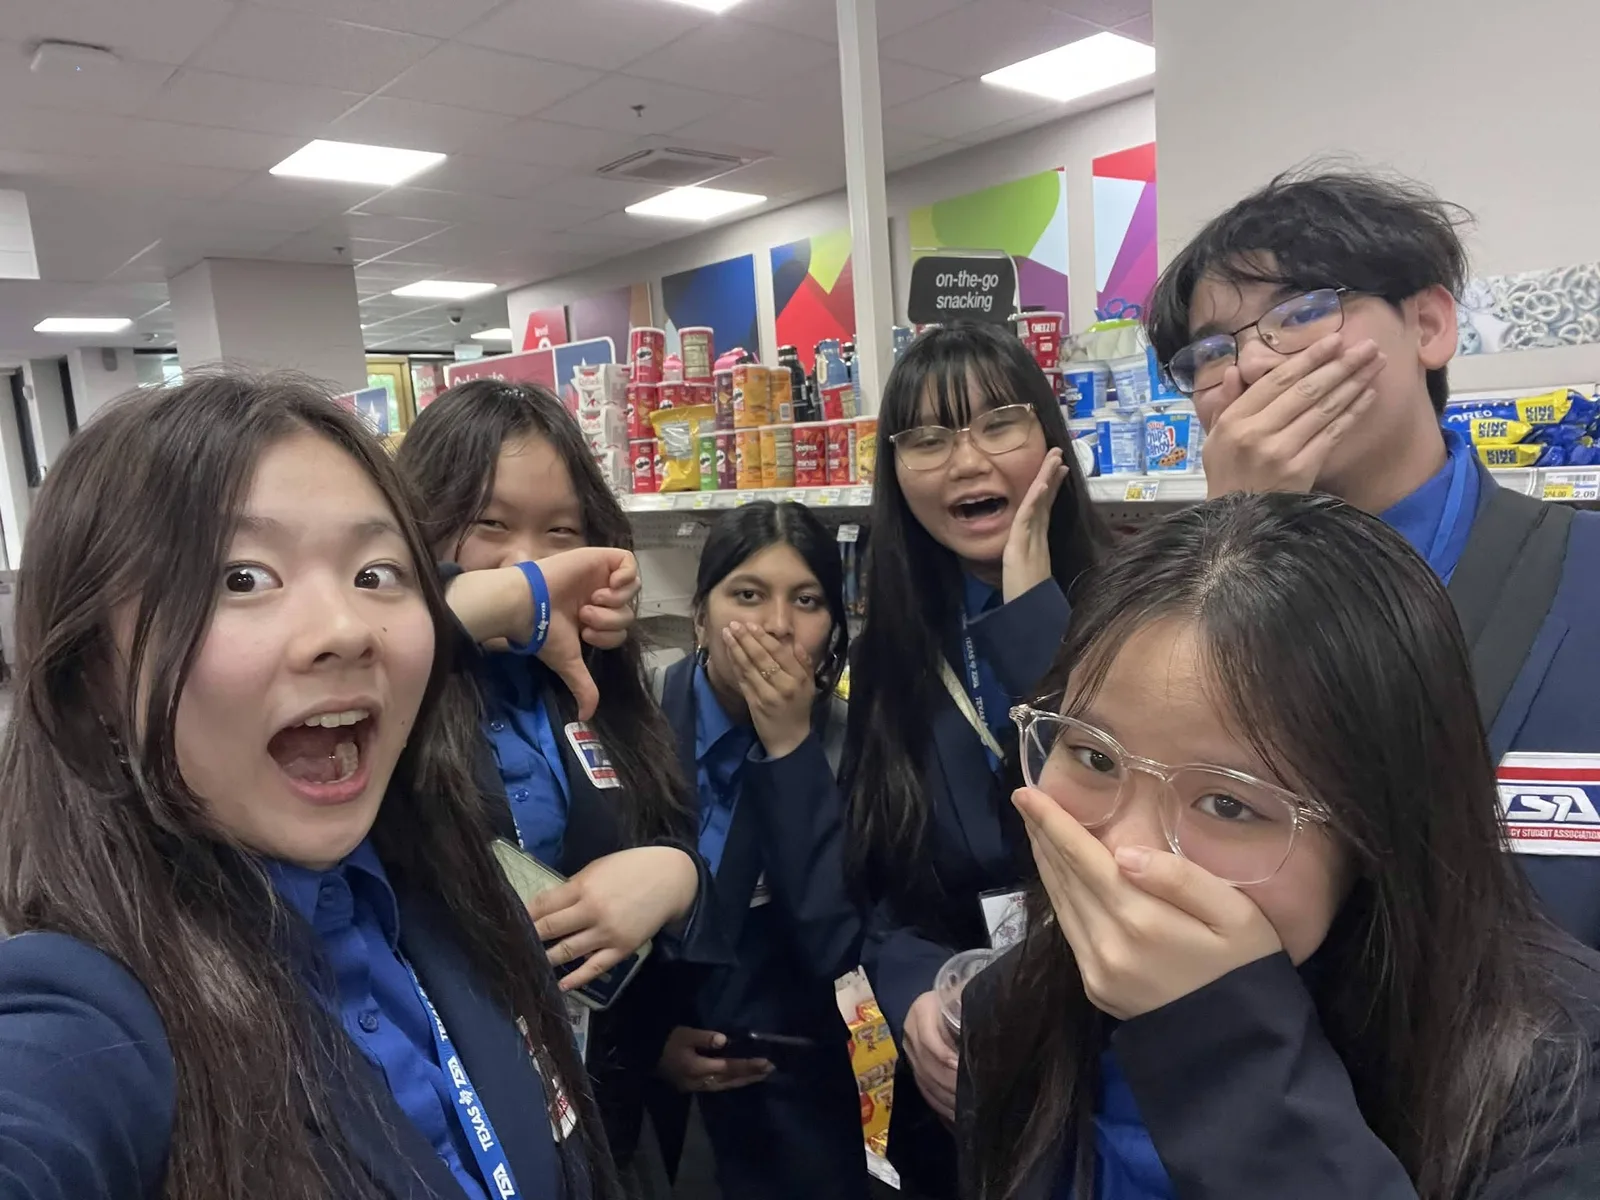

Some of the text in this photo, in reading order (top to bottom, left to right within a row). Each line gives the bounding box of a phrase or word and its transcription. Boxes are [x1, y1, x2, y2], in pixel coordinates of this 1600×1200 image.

[936, 270, 998, 291] on-the-go
[936, 292, 993, 312] snacking
[1448, 409, 1493, 423] OREO
[1522, 827, 1552, 838] STUDENT
[447, 1056, 494, 1152] TEXAS TSA
[492, 1162, 516, 1200] TSA
